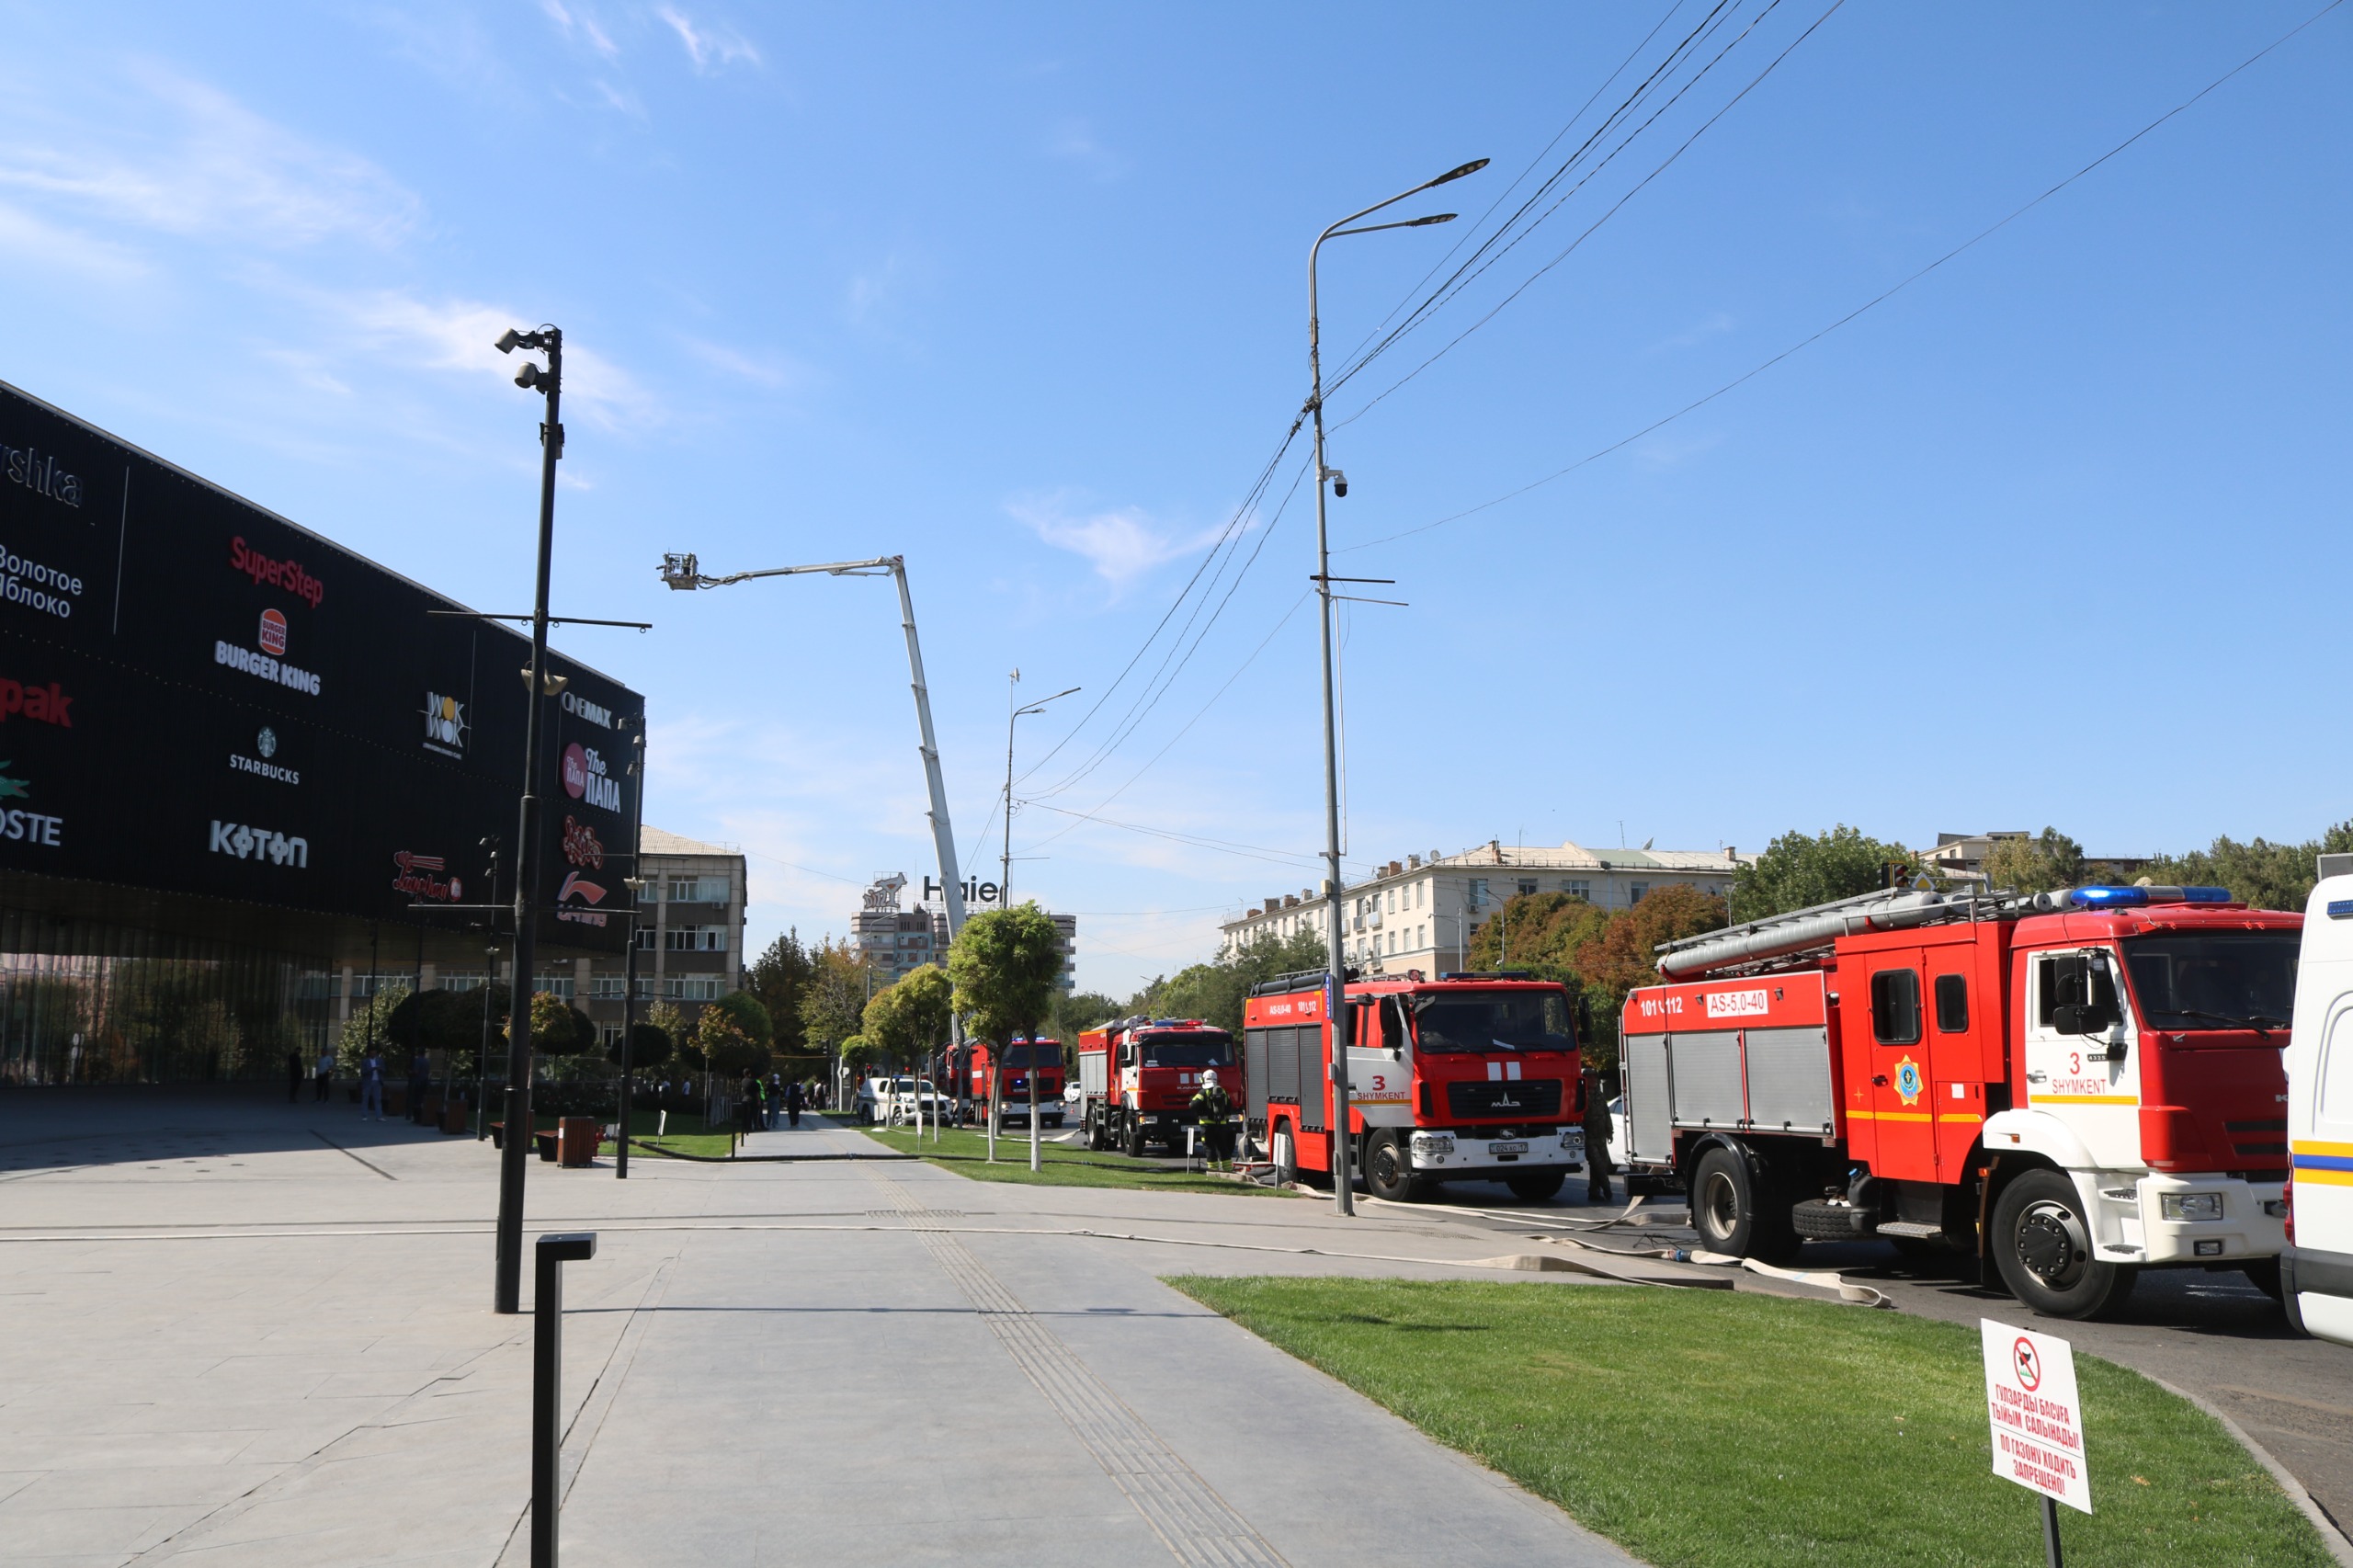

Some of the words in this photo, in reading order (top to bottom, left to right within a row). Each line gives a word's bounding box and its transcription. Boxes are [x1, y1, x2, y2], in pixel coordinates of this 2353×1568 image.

[231, 536, 324, 608] SuperStep
[261, 619, 286, 636] BURGER
[261, 629, 285, 648] KING
[214, 641, 279, 683] BURGER
[280, 664, 322, 696] KING
[230, 754, 300, 785] STARBUCKS
[585, 748, 608, 776] The
[585, 771, 621, 813] ПАПА
[1641, 999, 1657, 1017] 101
[1665, 996, 1683, 1015] 112
[1711, 992, 1765, 1015] AS-5,0-40
[842, 1067, 850, 1079] P
[2070, 1051, 2080, 1074] 3
[1372, 1075, 1386, 1091] 3
[2052, 1078, 2107, 1094] SHYMKENT
[1357, 1091, 1405, 1101] SHYMKENT
[2025, 1415, 2080, 1450] САЛЫНАДЫ!
[2000, 1434, 2010, 1453] ПО
[2011, 1438, 2041, 1464] ГАЗОНУ
[2042, 1449, 2076, 1480] ХОДИТЬ
[2013, 1459, 2066, 1496] ЗАПРЕЩЕНО!
